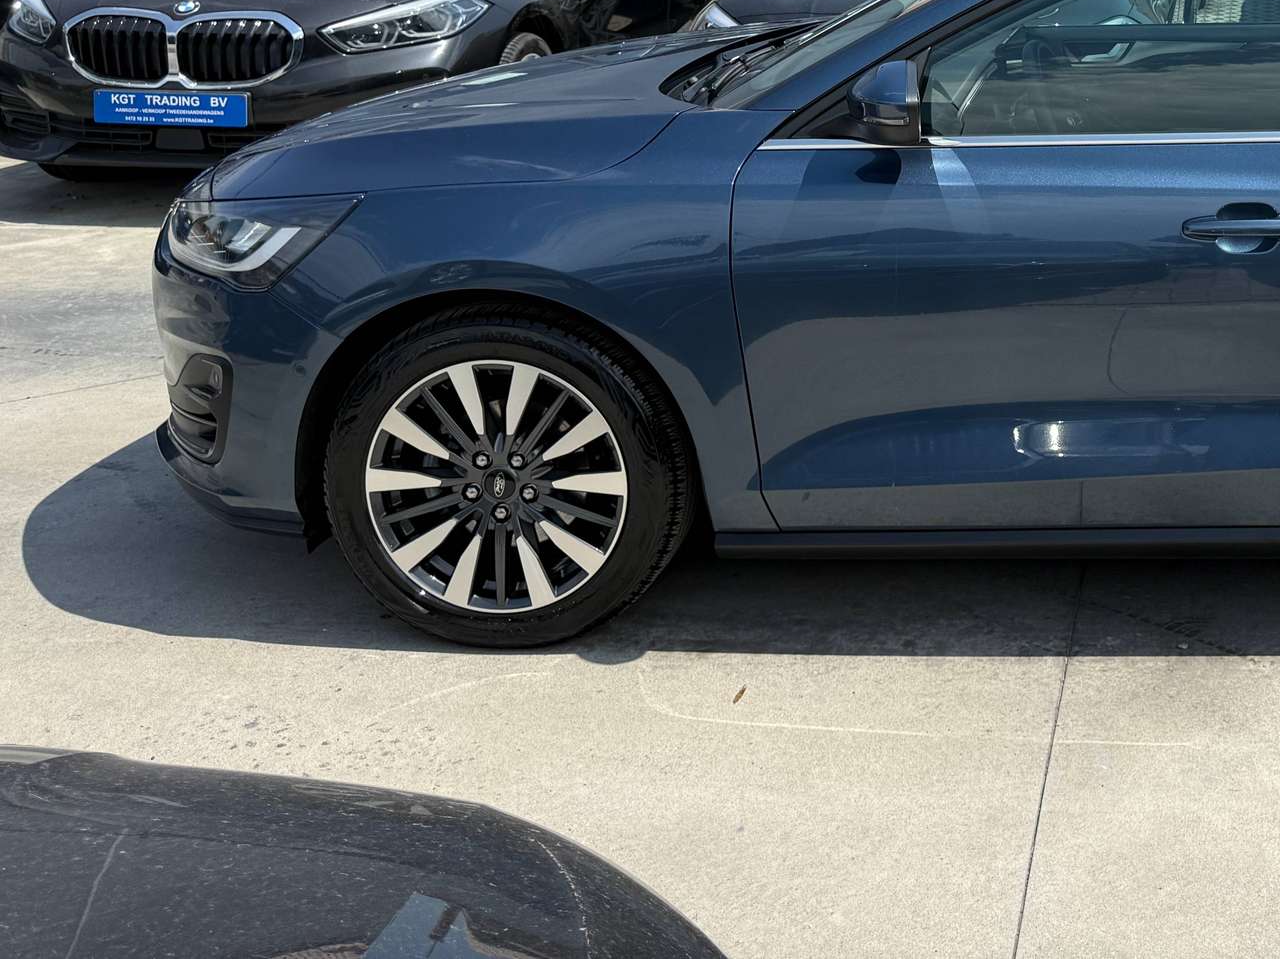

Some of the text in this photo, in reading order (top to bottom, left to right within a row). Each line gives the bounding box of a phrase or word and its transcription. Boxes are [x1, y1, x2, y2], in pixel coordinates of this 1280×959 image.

[111, 94, 228, 108] KGT TRADING BV
